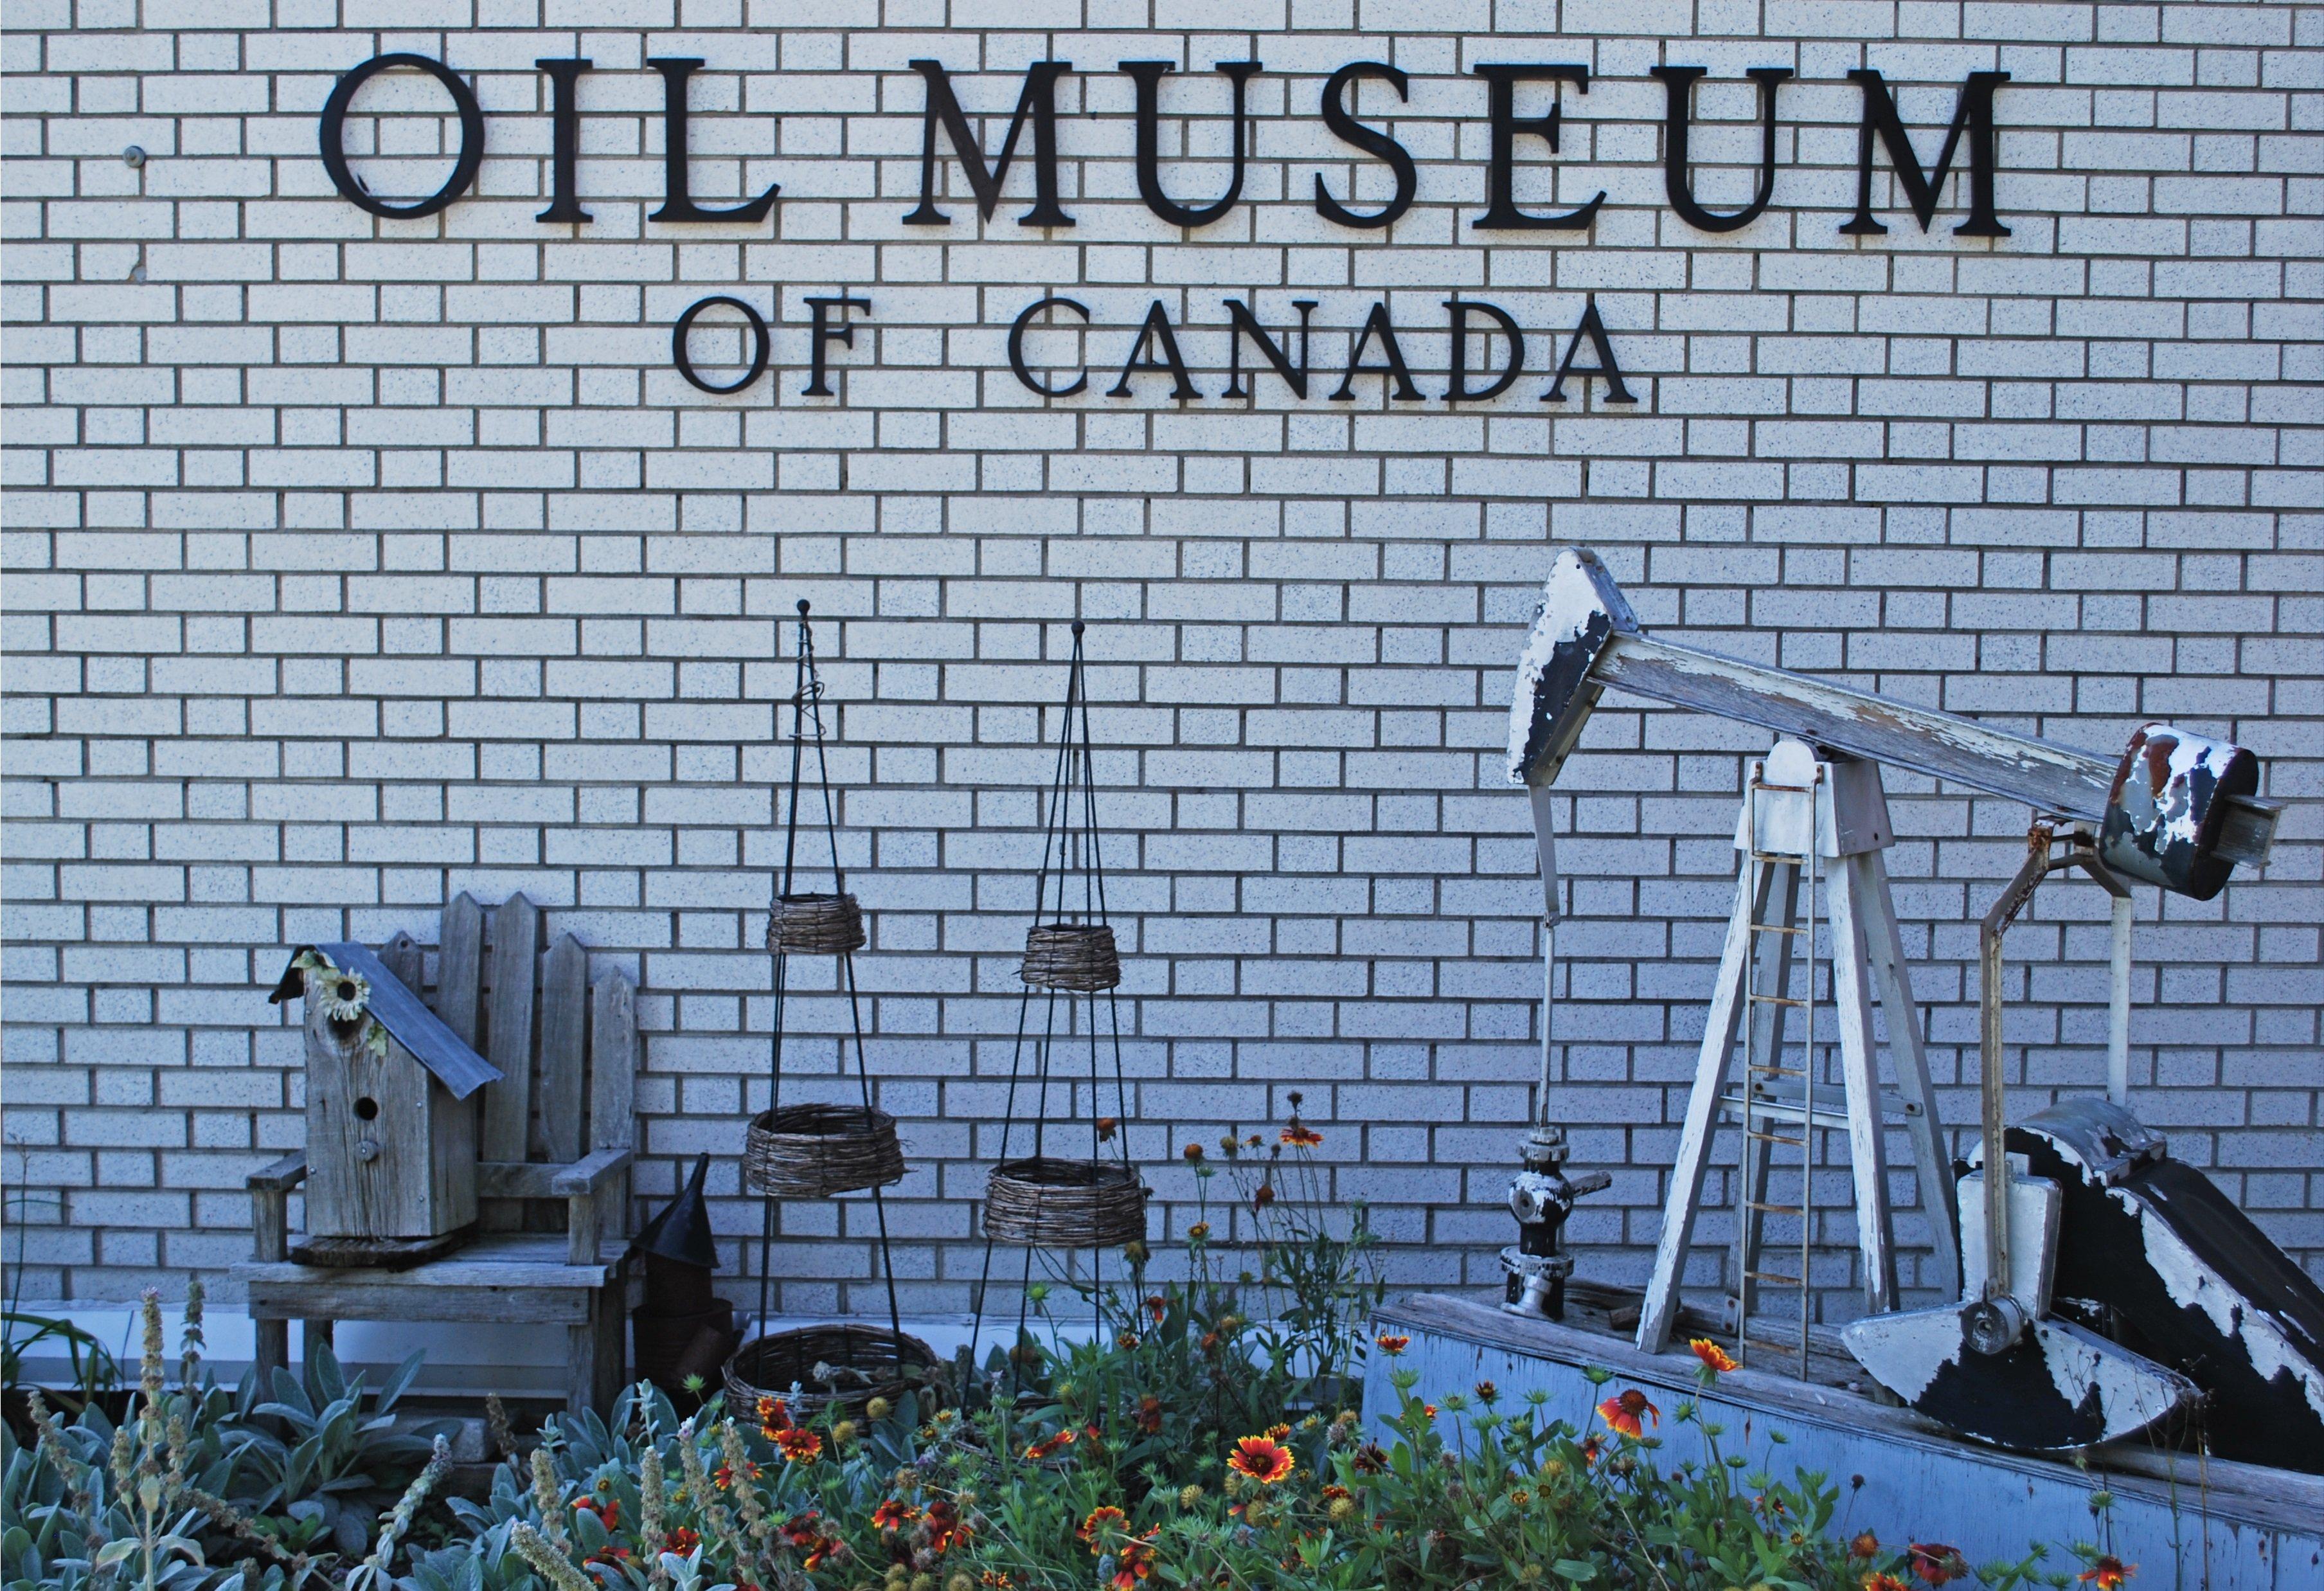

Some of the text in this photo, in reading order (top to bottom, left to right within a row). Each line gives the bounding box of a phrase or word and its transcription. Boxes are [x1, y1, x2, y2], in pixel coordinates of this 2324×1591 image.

[320, 53, 2012, 235] OIL MUSEUM
[672, 296, 1638, 403] OF CANADA
